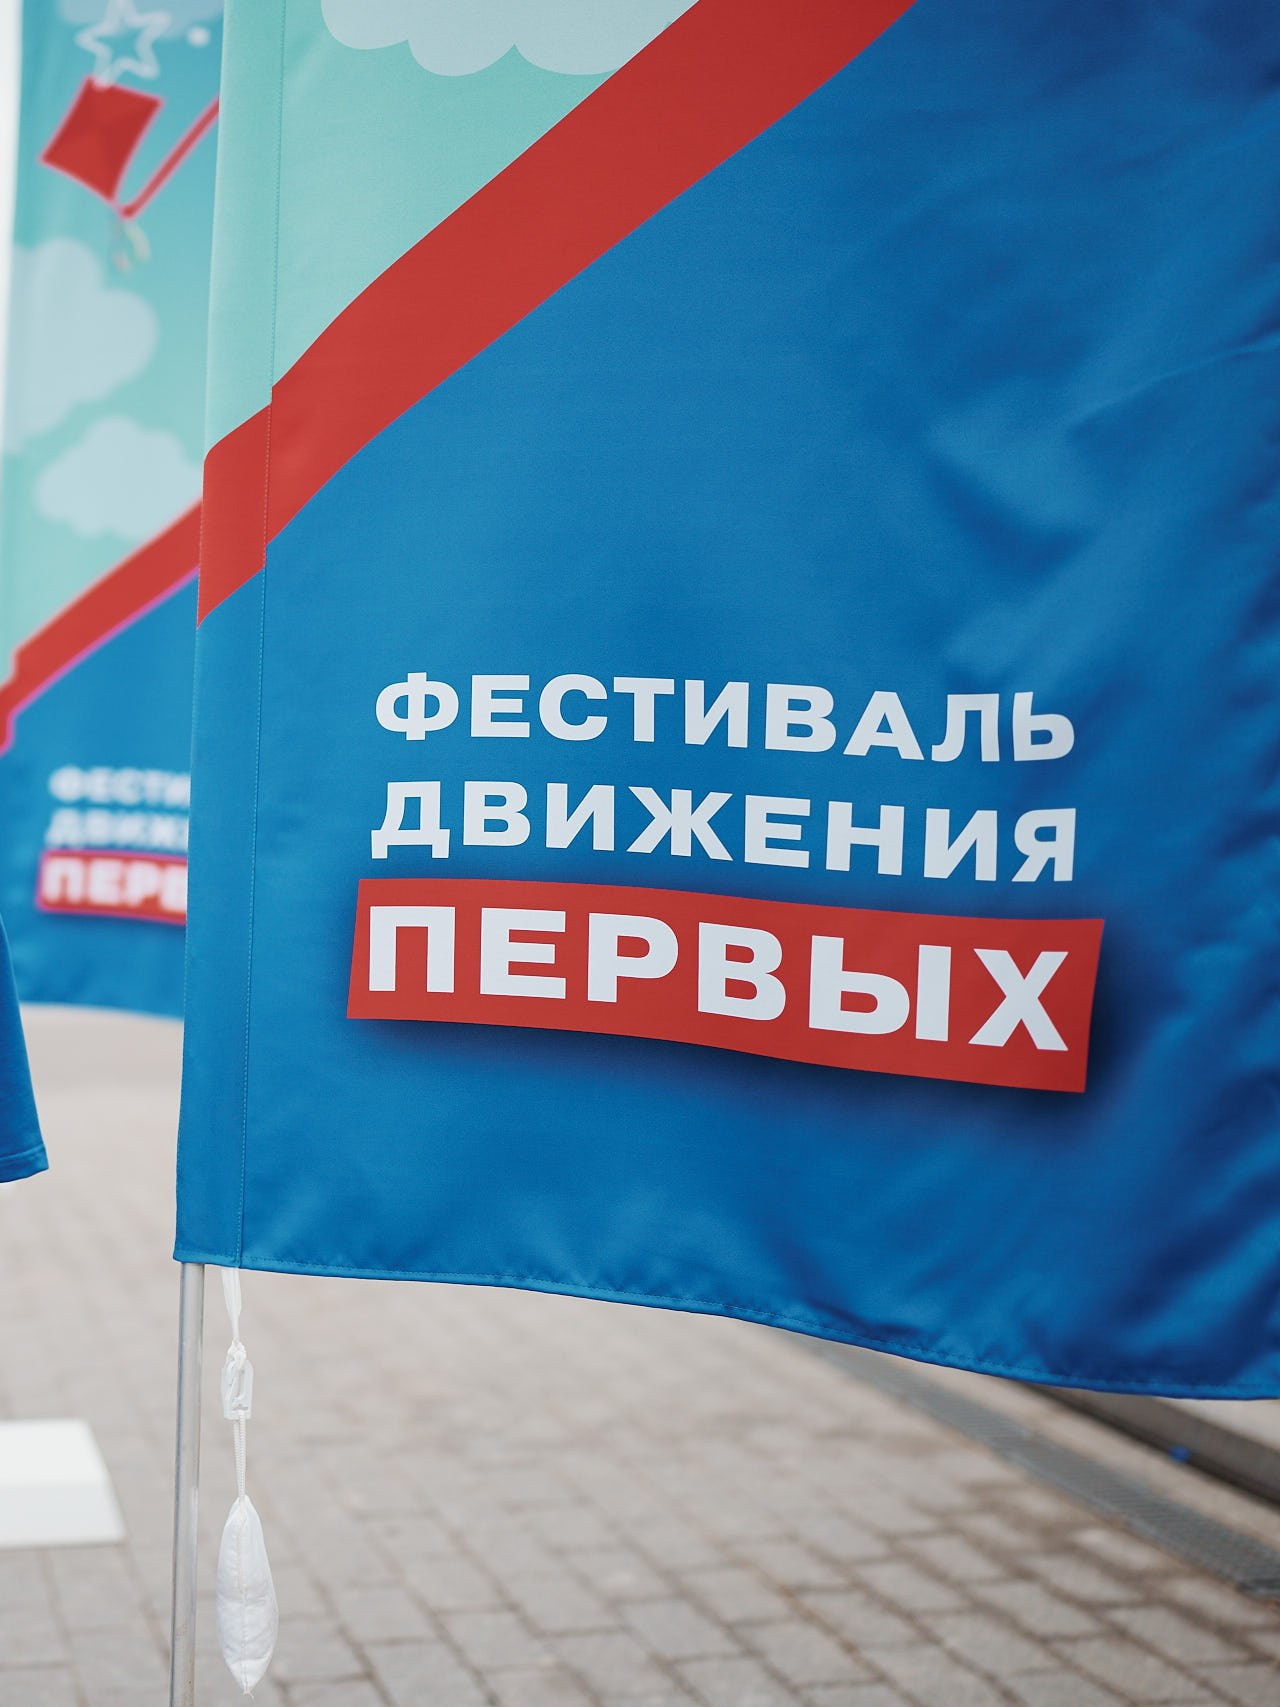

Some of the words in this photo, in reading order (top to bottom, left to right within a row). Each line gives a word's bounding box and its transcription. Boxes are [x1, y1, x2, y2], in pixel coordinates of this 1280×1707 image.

[376, 672, 1075, 762] ФЕСТИВАЛЬ
[371, 780, 1076, 882] ДВИЖЕНИЯ
[369, 905, 1069, 1051] ПЕРВЫХ
